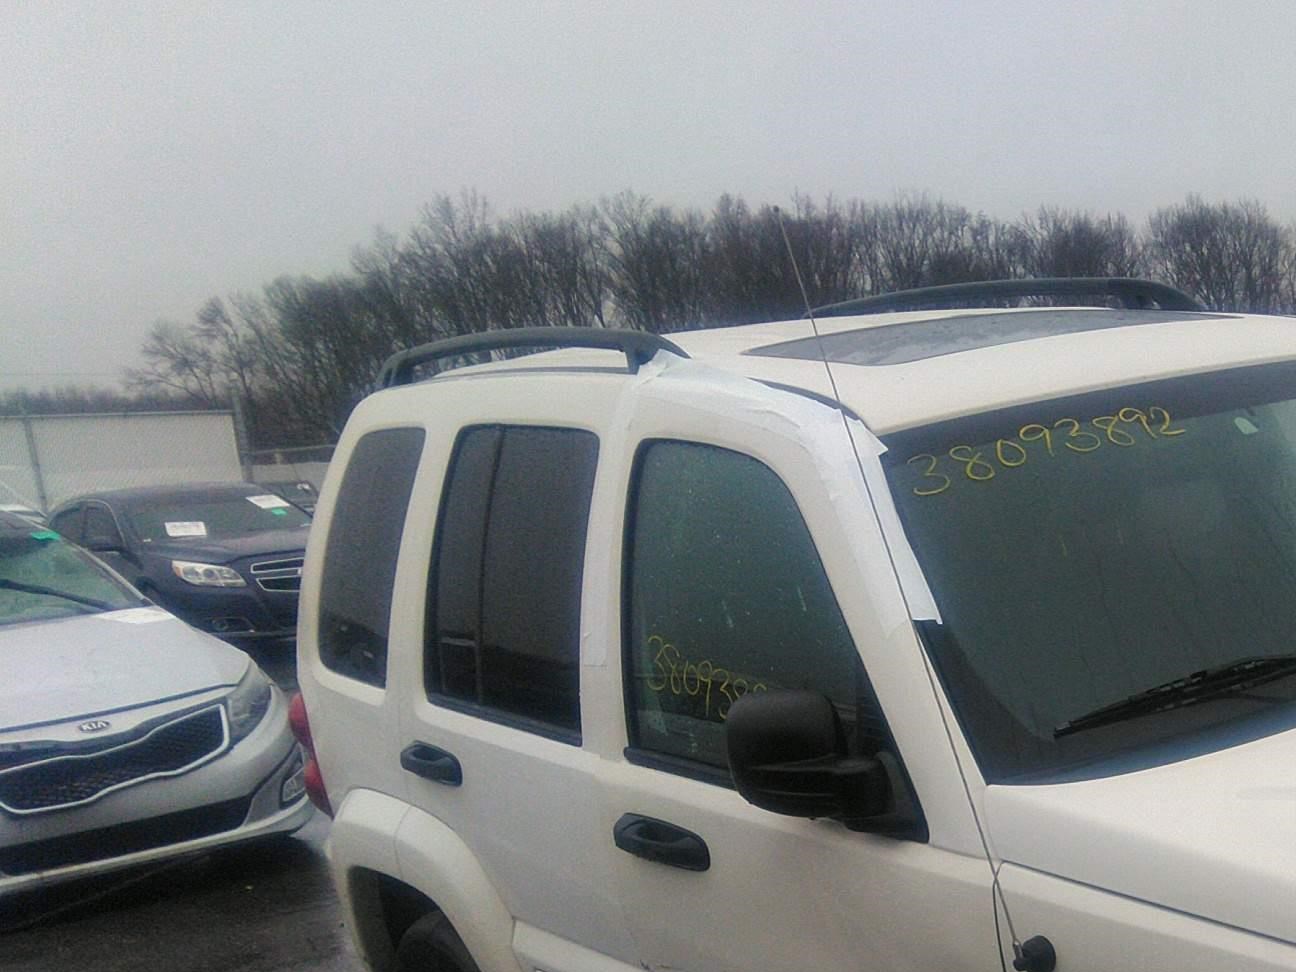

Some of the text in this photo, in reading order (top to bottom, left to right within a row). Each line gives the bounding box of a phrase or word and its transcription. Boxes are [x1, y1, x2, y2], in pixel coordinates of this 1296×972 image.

[906, 407, 1186, 495] 38093892
[647, 635, 767, 719] 38093
[80, 720, 109, 731] KIA
